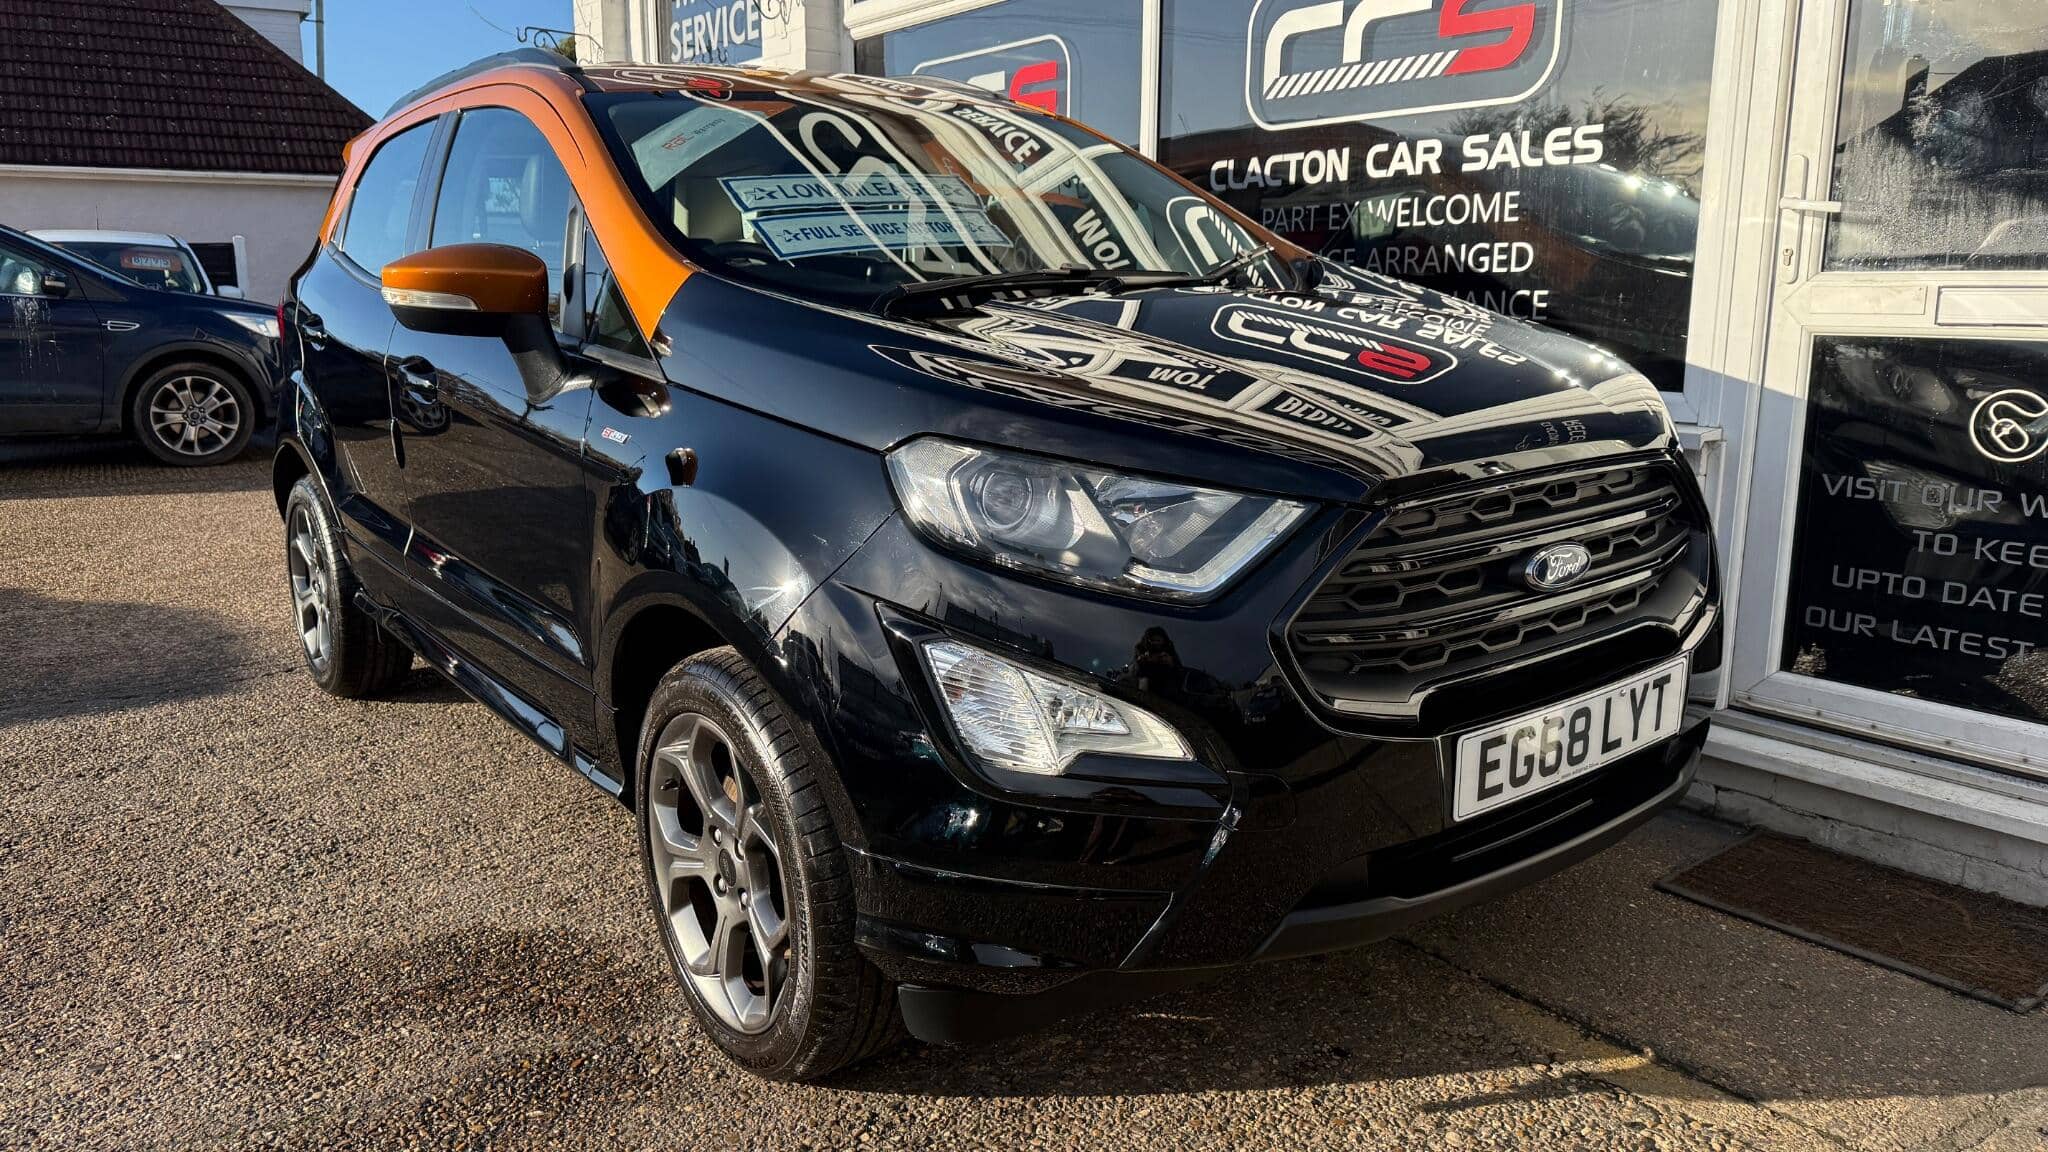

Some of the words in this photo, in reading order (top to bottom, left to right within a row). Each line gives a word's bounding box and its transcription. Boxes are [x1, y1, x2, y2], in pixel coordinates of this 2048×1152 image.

[670, 0, 760, 62] SERVICE
[1210, 147, 1350, 192] CLACTON
[1365, 138, 1443, 178] CAR
[1461, 124, 1604, 173] SALES
[777, 183, 833, 199] LOW
[1262, 204, 1320, 234] PART
[1328, 200, 1360, 231] EX
[1366, 190, 1520, 228] WELCOME
[800, 224, 842, 240] FULL
[903, 218, 965, 236] HISTOR
[1365, 241, 1534, 276] ARRANGED
[1822, 473, 1907, 502] VISIT
[1921, 484, 2003, 514] OUR
[1547, 552, 1581, 580] Ford
[1912, 529, 1959, 556] TO
[1974, 537, 2048, 569] KEE
[1832, 564, 1926, 599] UPTO
[1942, 581, 2045, 618] DATE
[1804, 605, 1878, 638] OUR
[1890, 619, 2036, 665] LATEST
[1477, 706, 1592, 802] EG68
[1600, 673, 1671, 755] LYT
